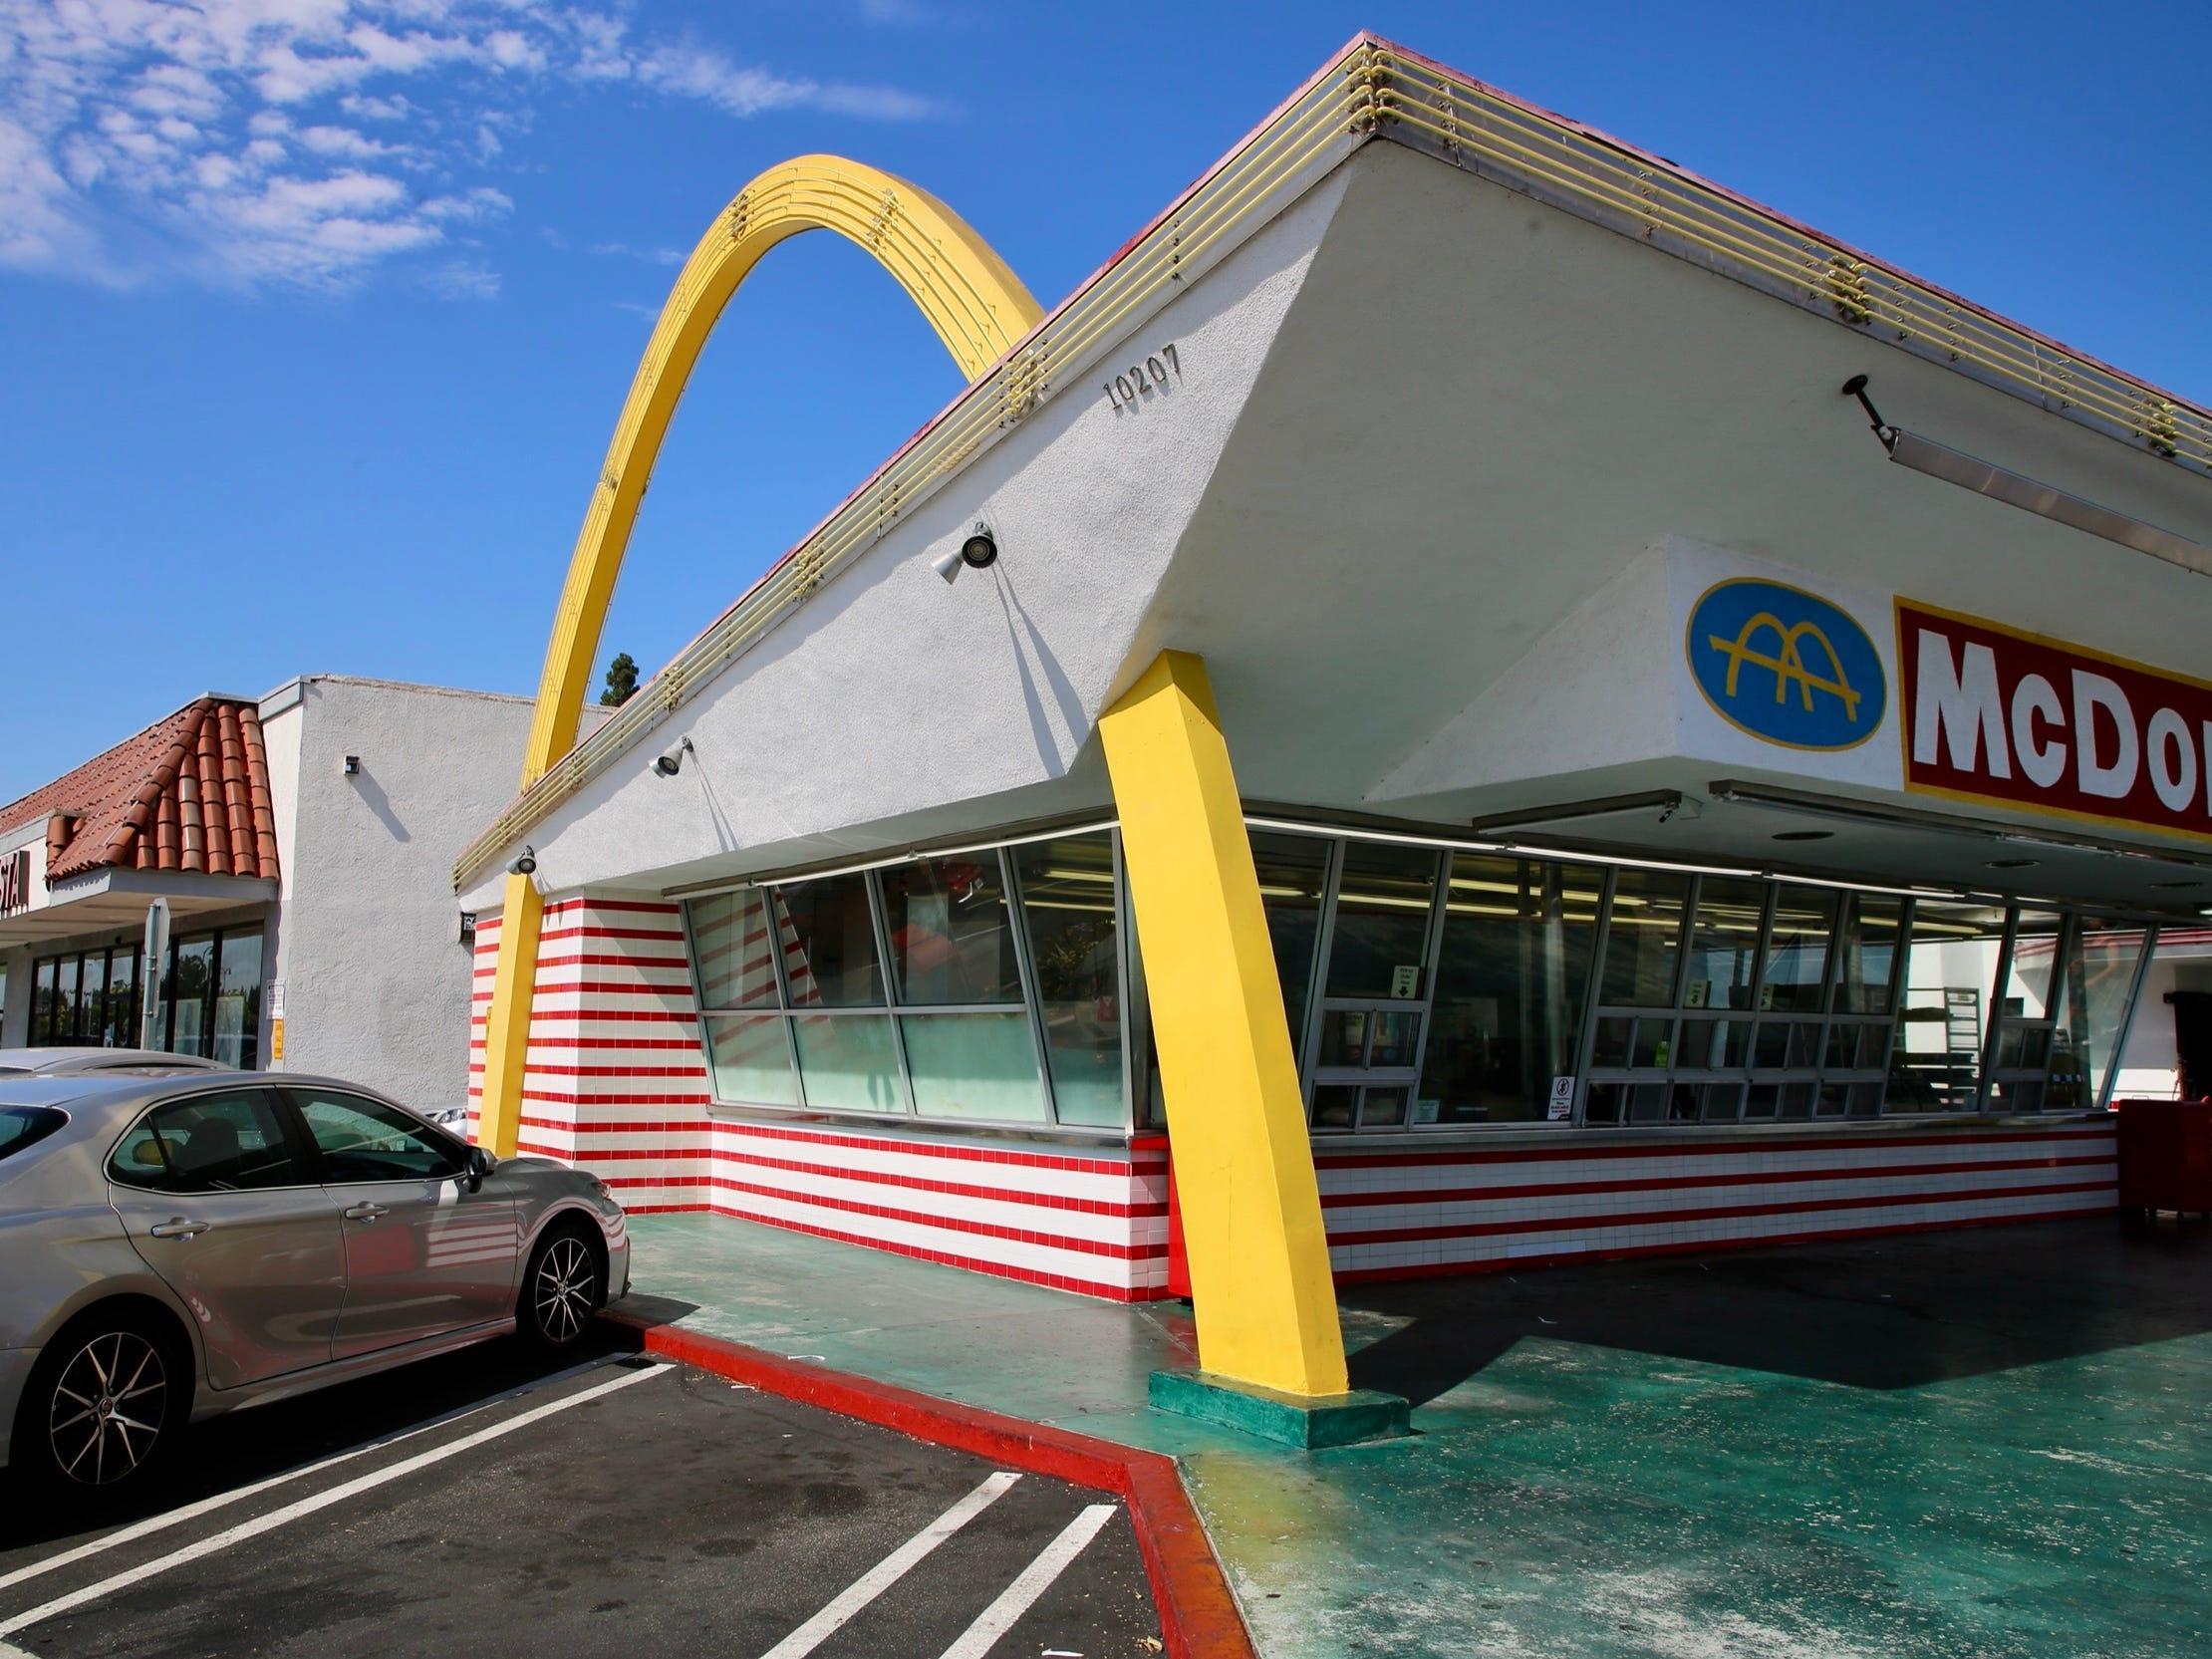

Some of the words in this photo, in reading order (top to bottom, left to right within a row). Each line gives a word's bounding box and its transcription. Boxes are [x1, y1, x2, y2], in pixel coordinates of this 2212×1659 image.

[1103, 343, 1180, 410] 10207
[1913, 628, 2212, 818] McDo
[0, 851, 30, 911] TA
